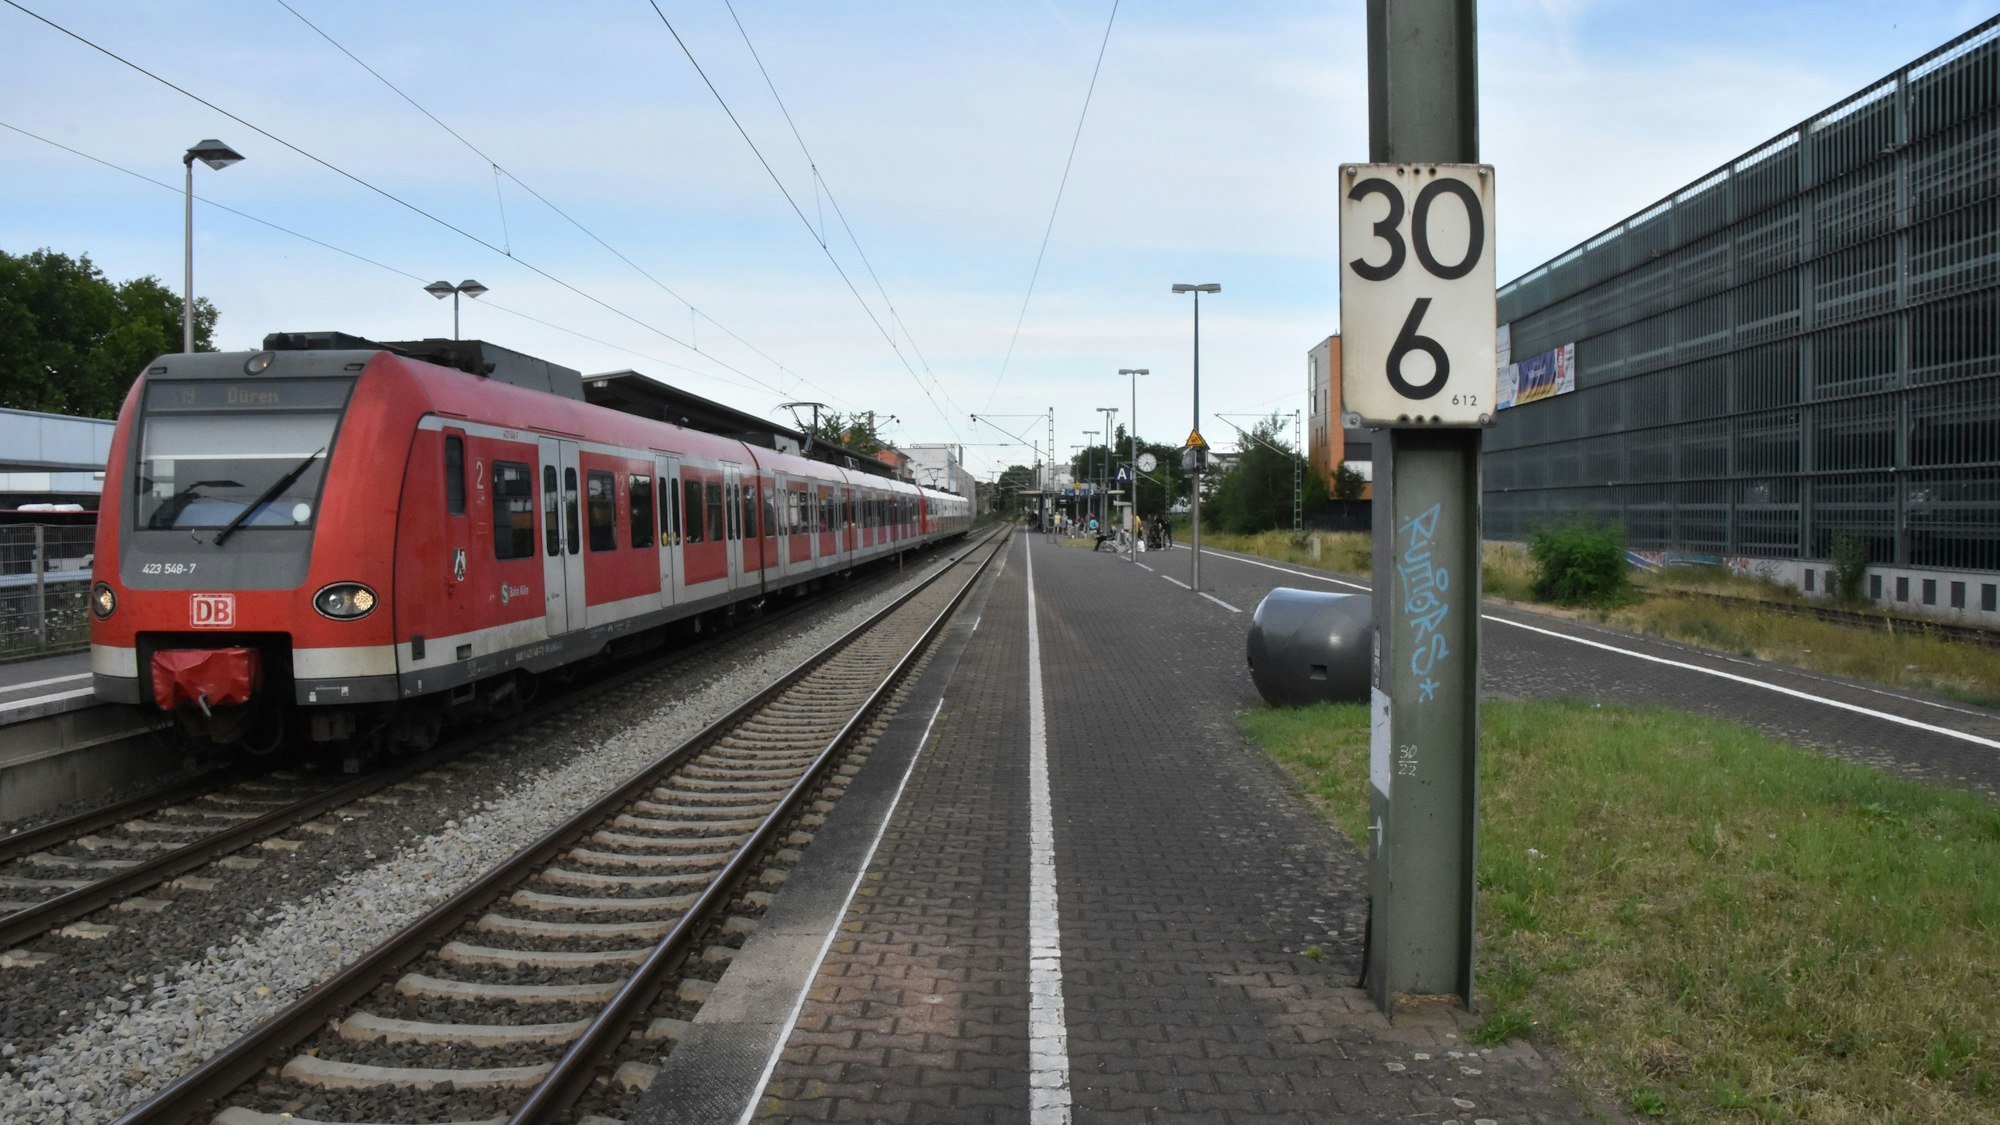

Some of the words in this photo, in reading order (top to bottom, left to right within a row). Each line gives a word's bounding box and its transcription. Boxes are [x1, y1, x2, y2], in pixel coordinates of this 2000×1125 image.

[1348, 178, 1484, 281] 30
[1386, 298, 1450, 400] 6
[228, 386, 279, 404] Düren
[1452, 395, 1477, 407] 612
[476, 460, 484, 490] 2
[1117, 468, 1127, 480] A
[142, 563, 162, 574] 423
[196, 600, 230, 622] DB
[1400, 744, 1418, 759] 30
[1398, 763, 1417, 777] 22
